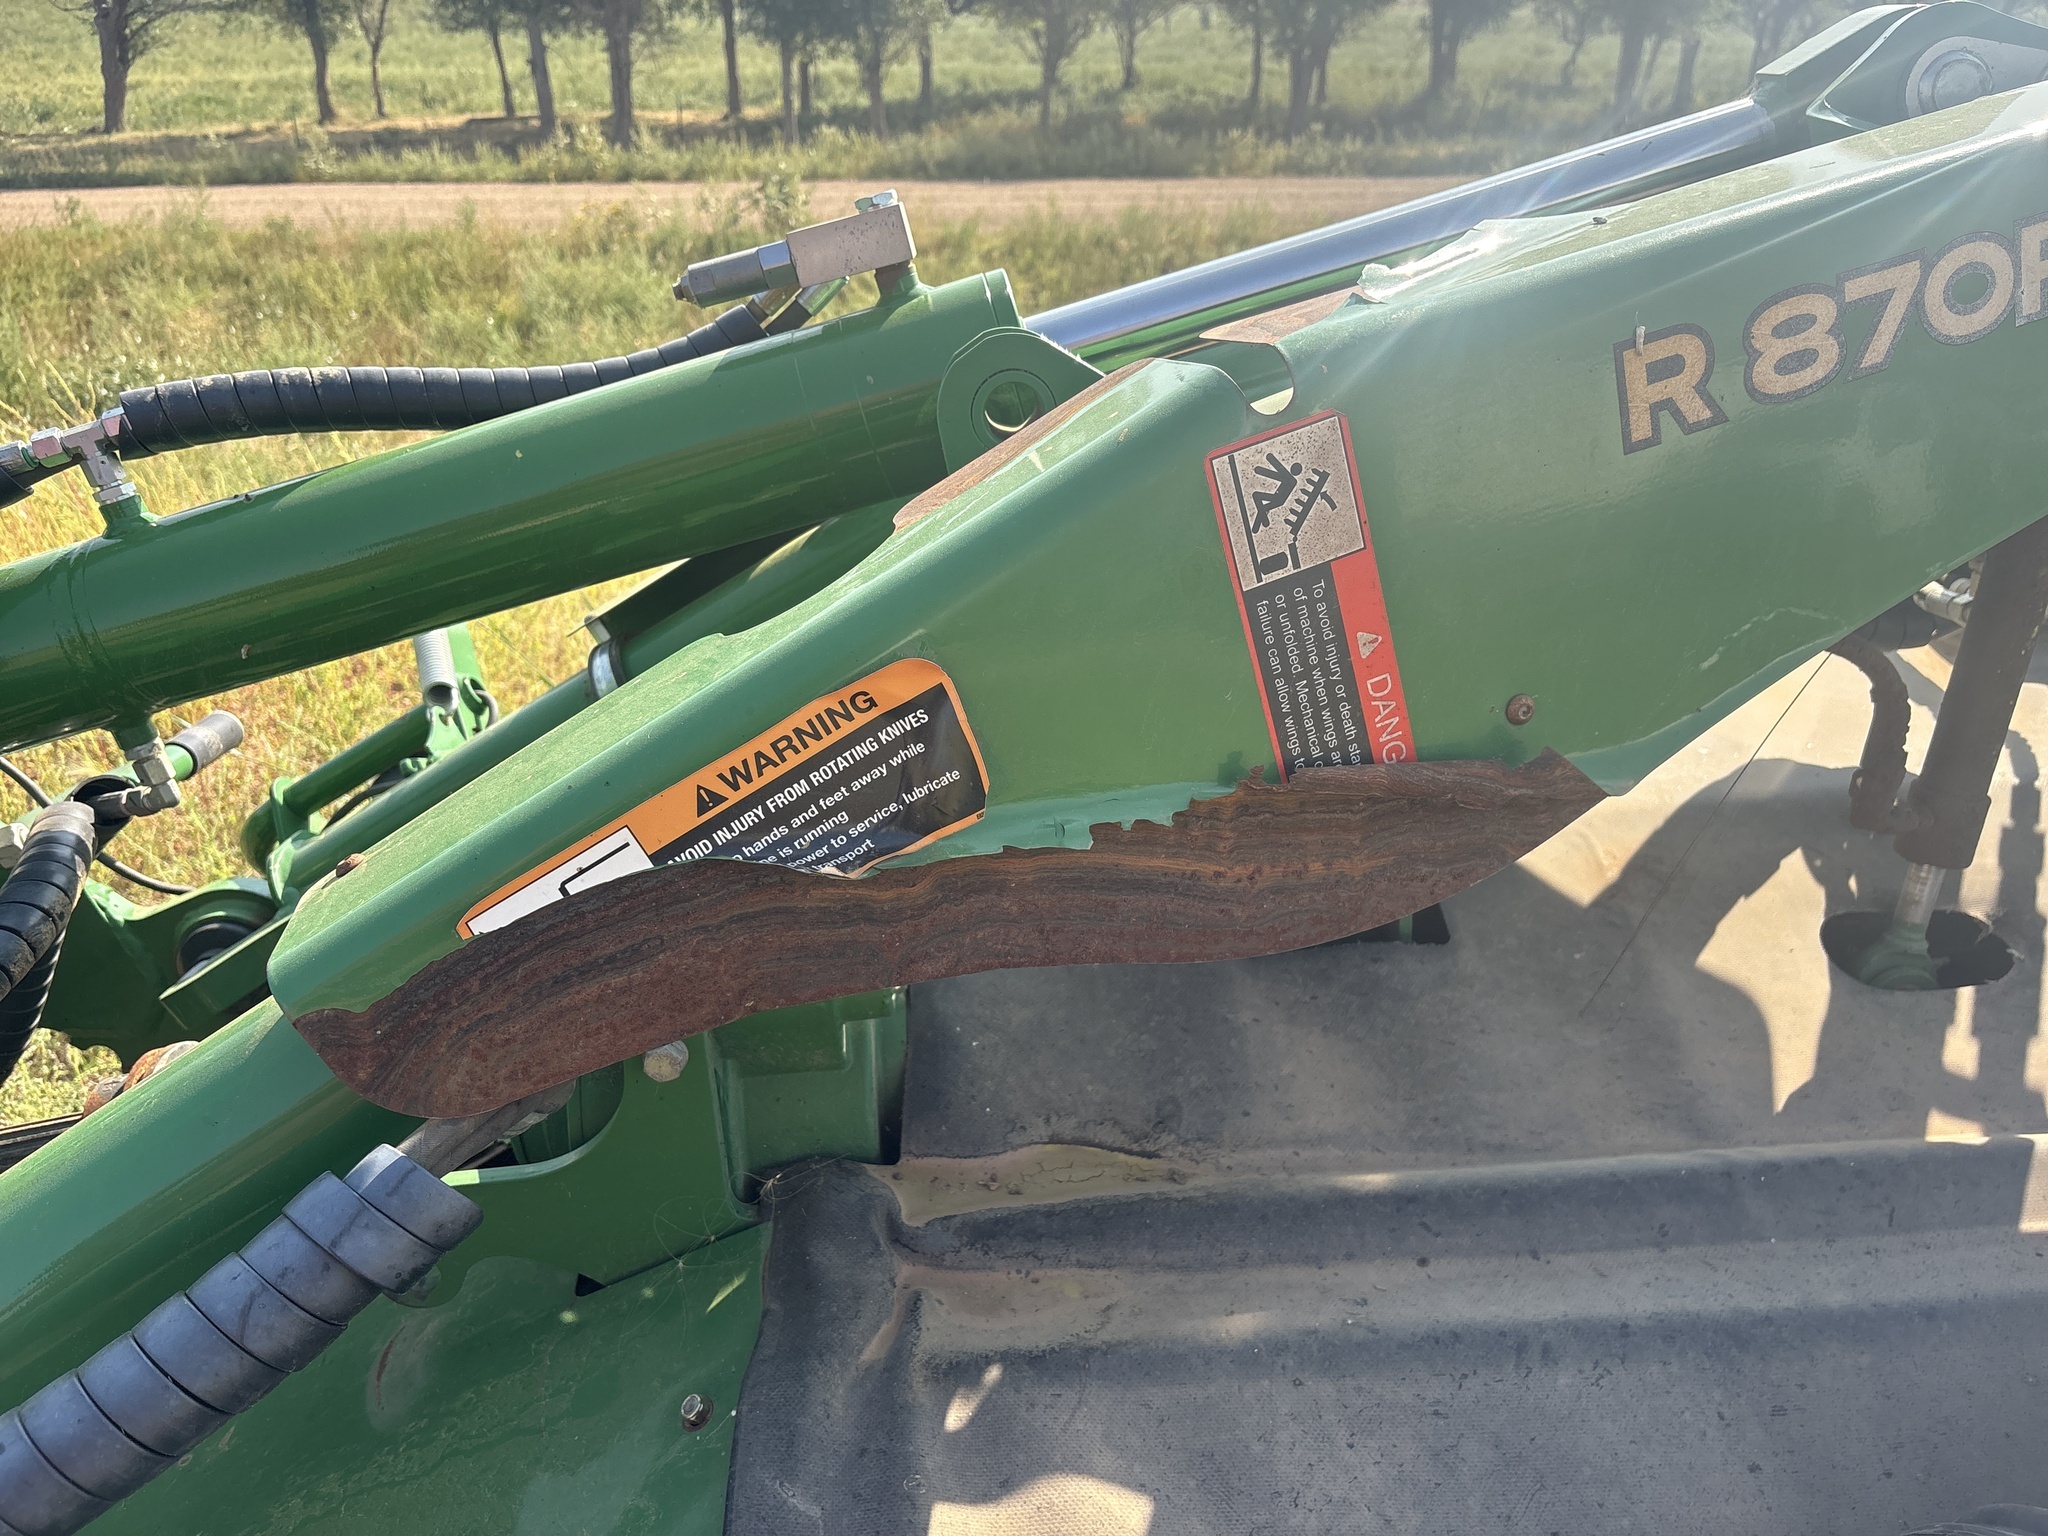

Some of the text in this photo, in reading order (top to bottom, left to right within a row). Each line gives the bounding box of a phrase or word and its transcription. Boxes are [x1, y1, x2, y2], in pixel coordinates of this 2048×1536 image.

[1613, 323, 1730, 455] R
[1293, 587, 1308, 601] of
[1256, 600, 1275, 645] failure
[1297, 605, 1319, 665] machine
[1268, 648, 1282, 675] can
[1275, 594, 1324, 759] or unfolded. Mechanical
[1312, 579, 1362, 765] To avoid injury or death sta
[1312, 667, 1328, 706] when
[1274, 677, 1292, 713] allow
[716, 690, 879, 792] WARNING
[1284, 715, 1301, 756] wings
[1321, 708, 1338, 748] wings
[667, 708, 929, 865] VOID INJURY FROM ROTATING KNIVES
[742, 741, 926, 857] hands and feet away while
[830, 835, 847, 848] to
[848, 801, 904, 838] service,
[902, 769, 961, 805] lubricate
[777, 811, 849, 858] is running
